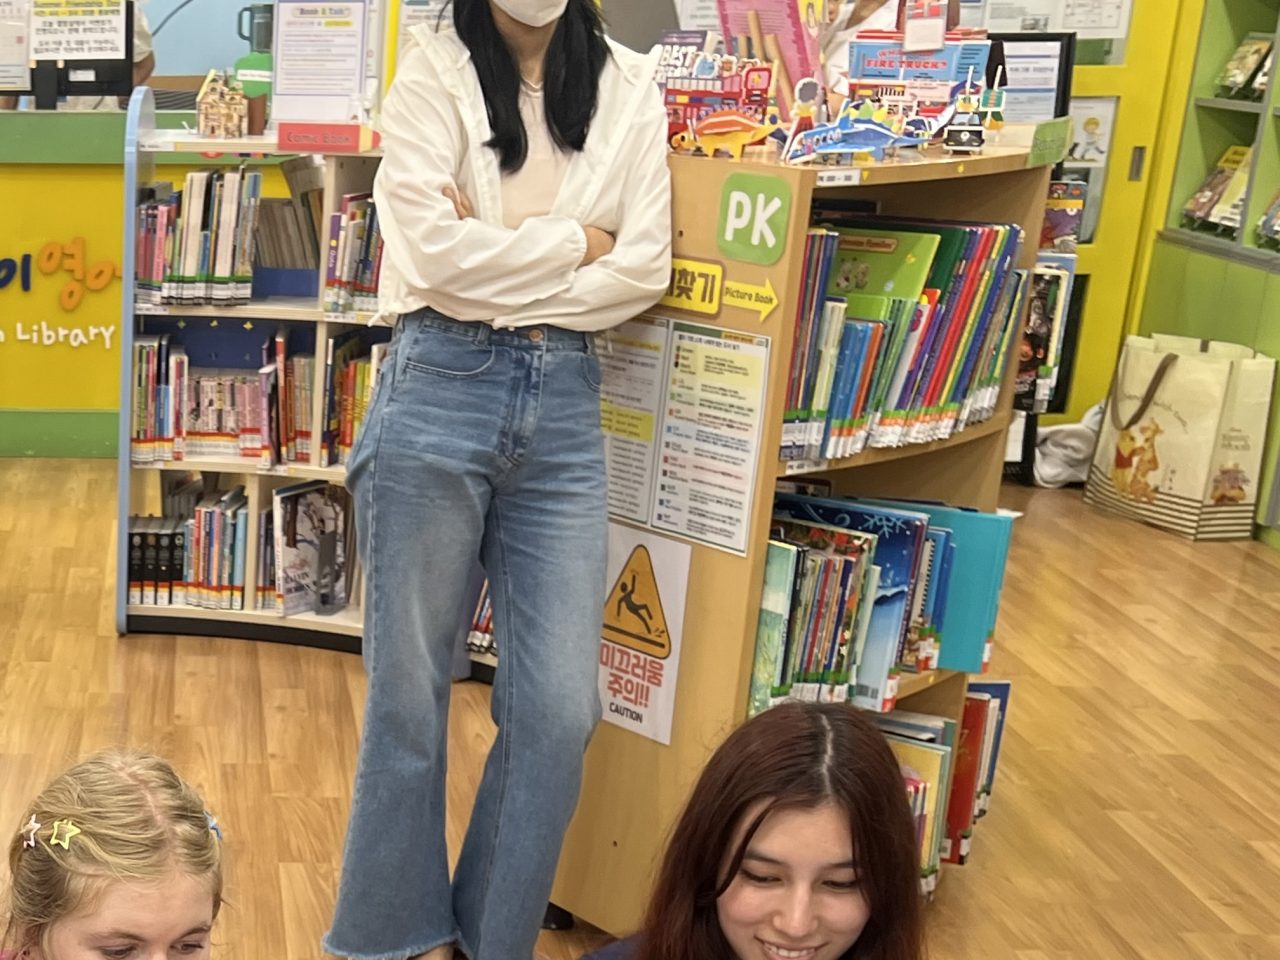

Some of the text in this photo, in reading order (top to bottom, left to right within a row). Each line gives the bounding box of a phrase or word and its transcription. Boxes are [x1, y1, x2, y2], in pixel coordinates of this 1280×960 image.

[661, 45, 698, 67] BEST
[866, 58, 948, 70] FIRE TRUCK?
[725, 190, 781, 249] PK
[725, 286, 774, 305] Picture Book
[16, 320, 116, 349] Library
[600, 641, 665, 688] 미끄러움
[607, 671, 651, 709] 주의!!
[609, 702, 643, 724] CAUTION
